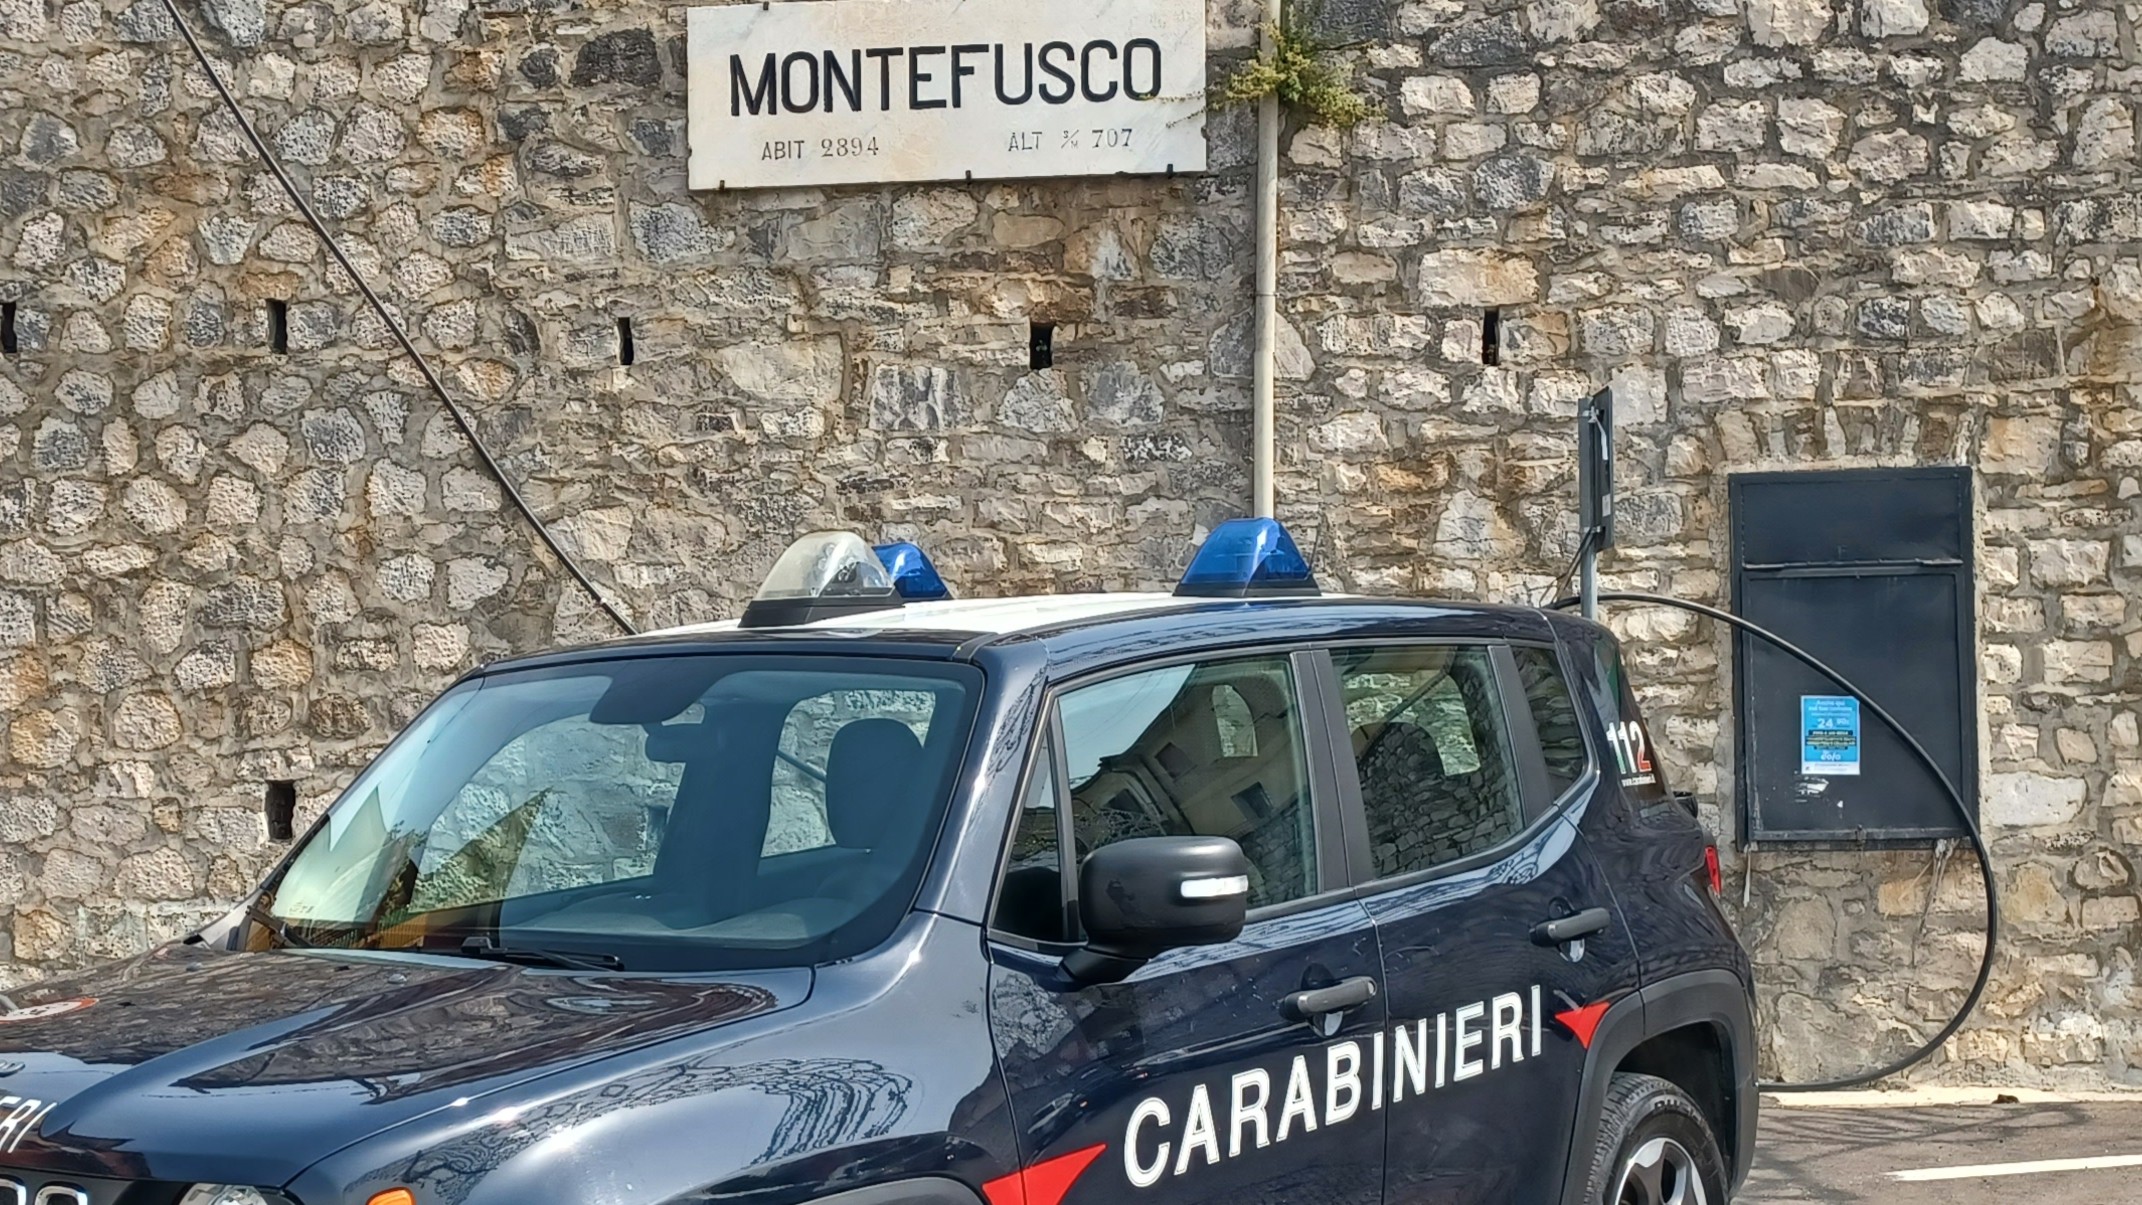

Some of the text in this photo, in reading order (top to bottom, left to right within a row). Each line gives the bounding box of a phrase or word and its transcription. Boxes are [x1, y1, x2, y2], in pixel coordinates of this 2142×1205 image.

[729, 37, 1163, 116] MONTEFUSCO
[761, 136, 880, 161] ABIT 2894
[1008, 131, 1042, 152] ALT
[1091, 128, 1133, 148] 707
[1817, 718, 1834, 728] 24
[1606, 720, 1652, 774] 112
[1124, 984, 1542, 1188] CARABINIERI
